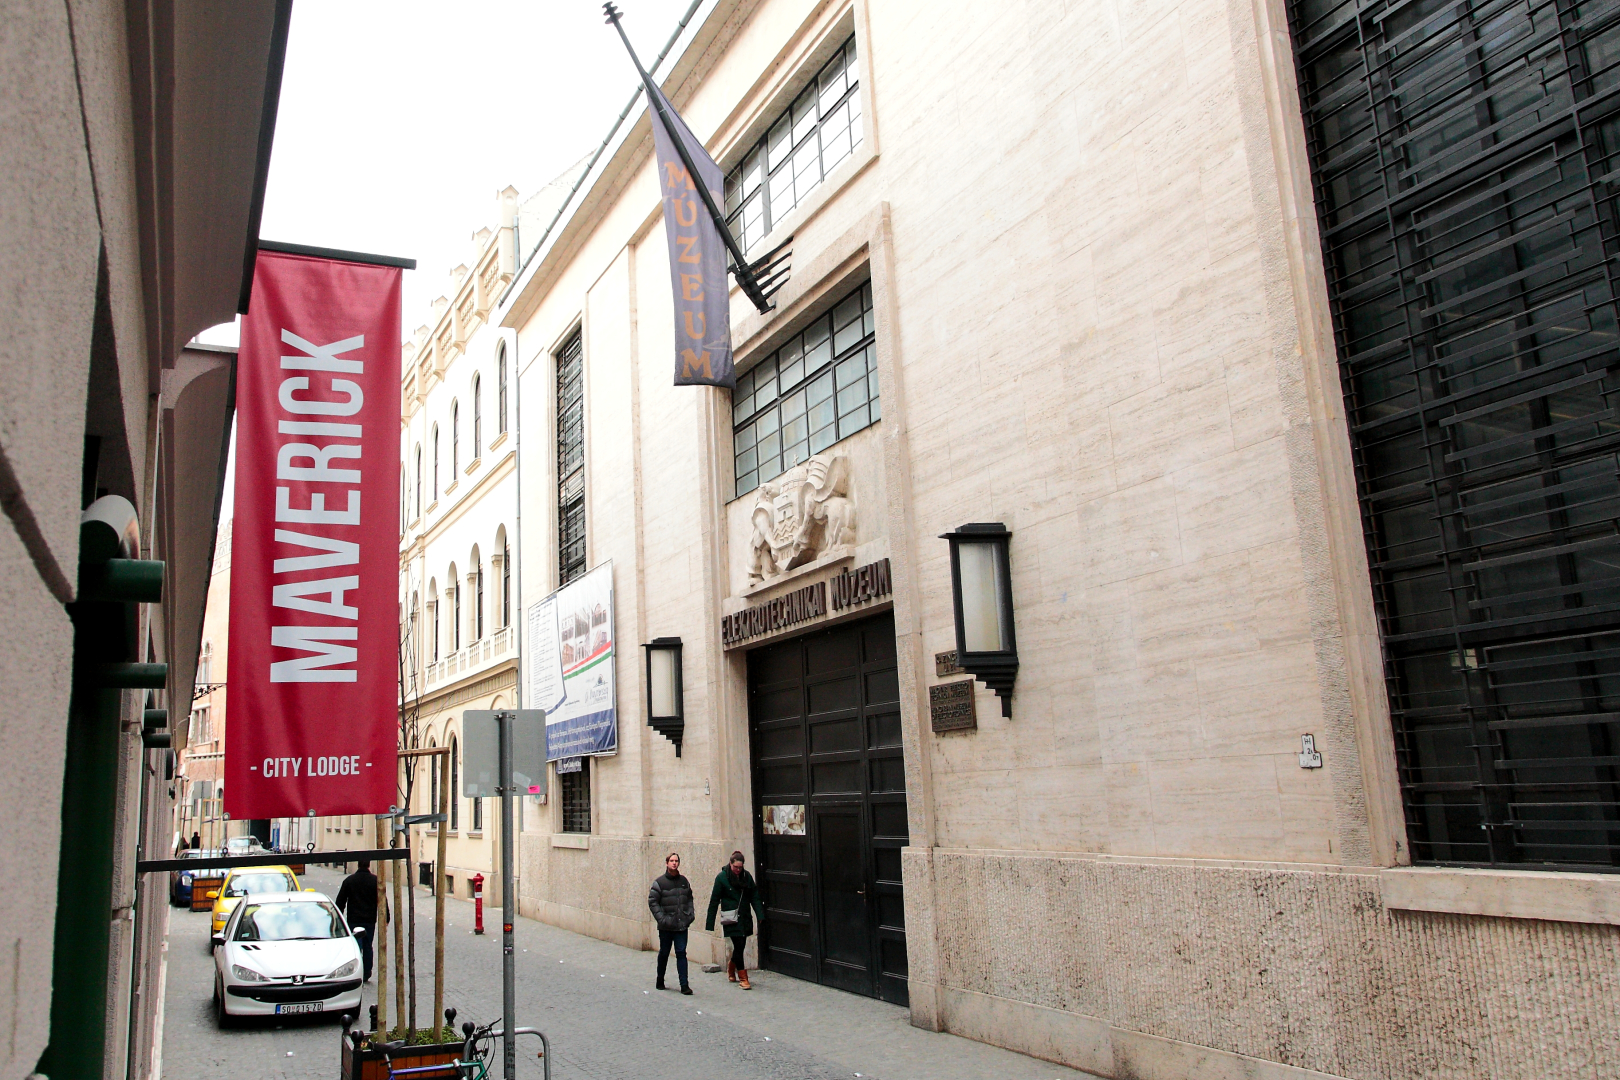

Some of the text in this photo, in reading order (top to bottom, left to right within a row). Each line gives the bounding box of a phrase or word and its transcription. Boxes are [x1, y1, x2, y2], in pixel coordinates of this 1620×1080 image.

[664, 161, 714, 379] MÚZEUM
[270, 328, 365, 683] MAVERICK
[721, 582, 827, 643] ELEKTROTECHNIKAI
[263, 755, 360, 778] CITY LODGE
